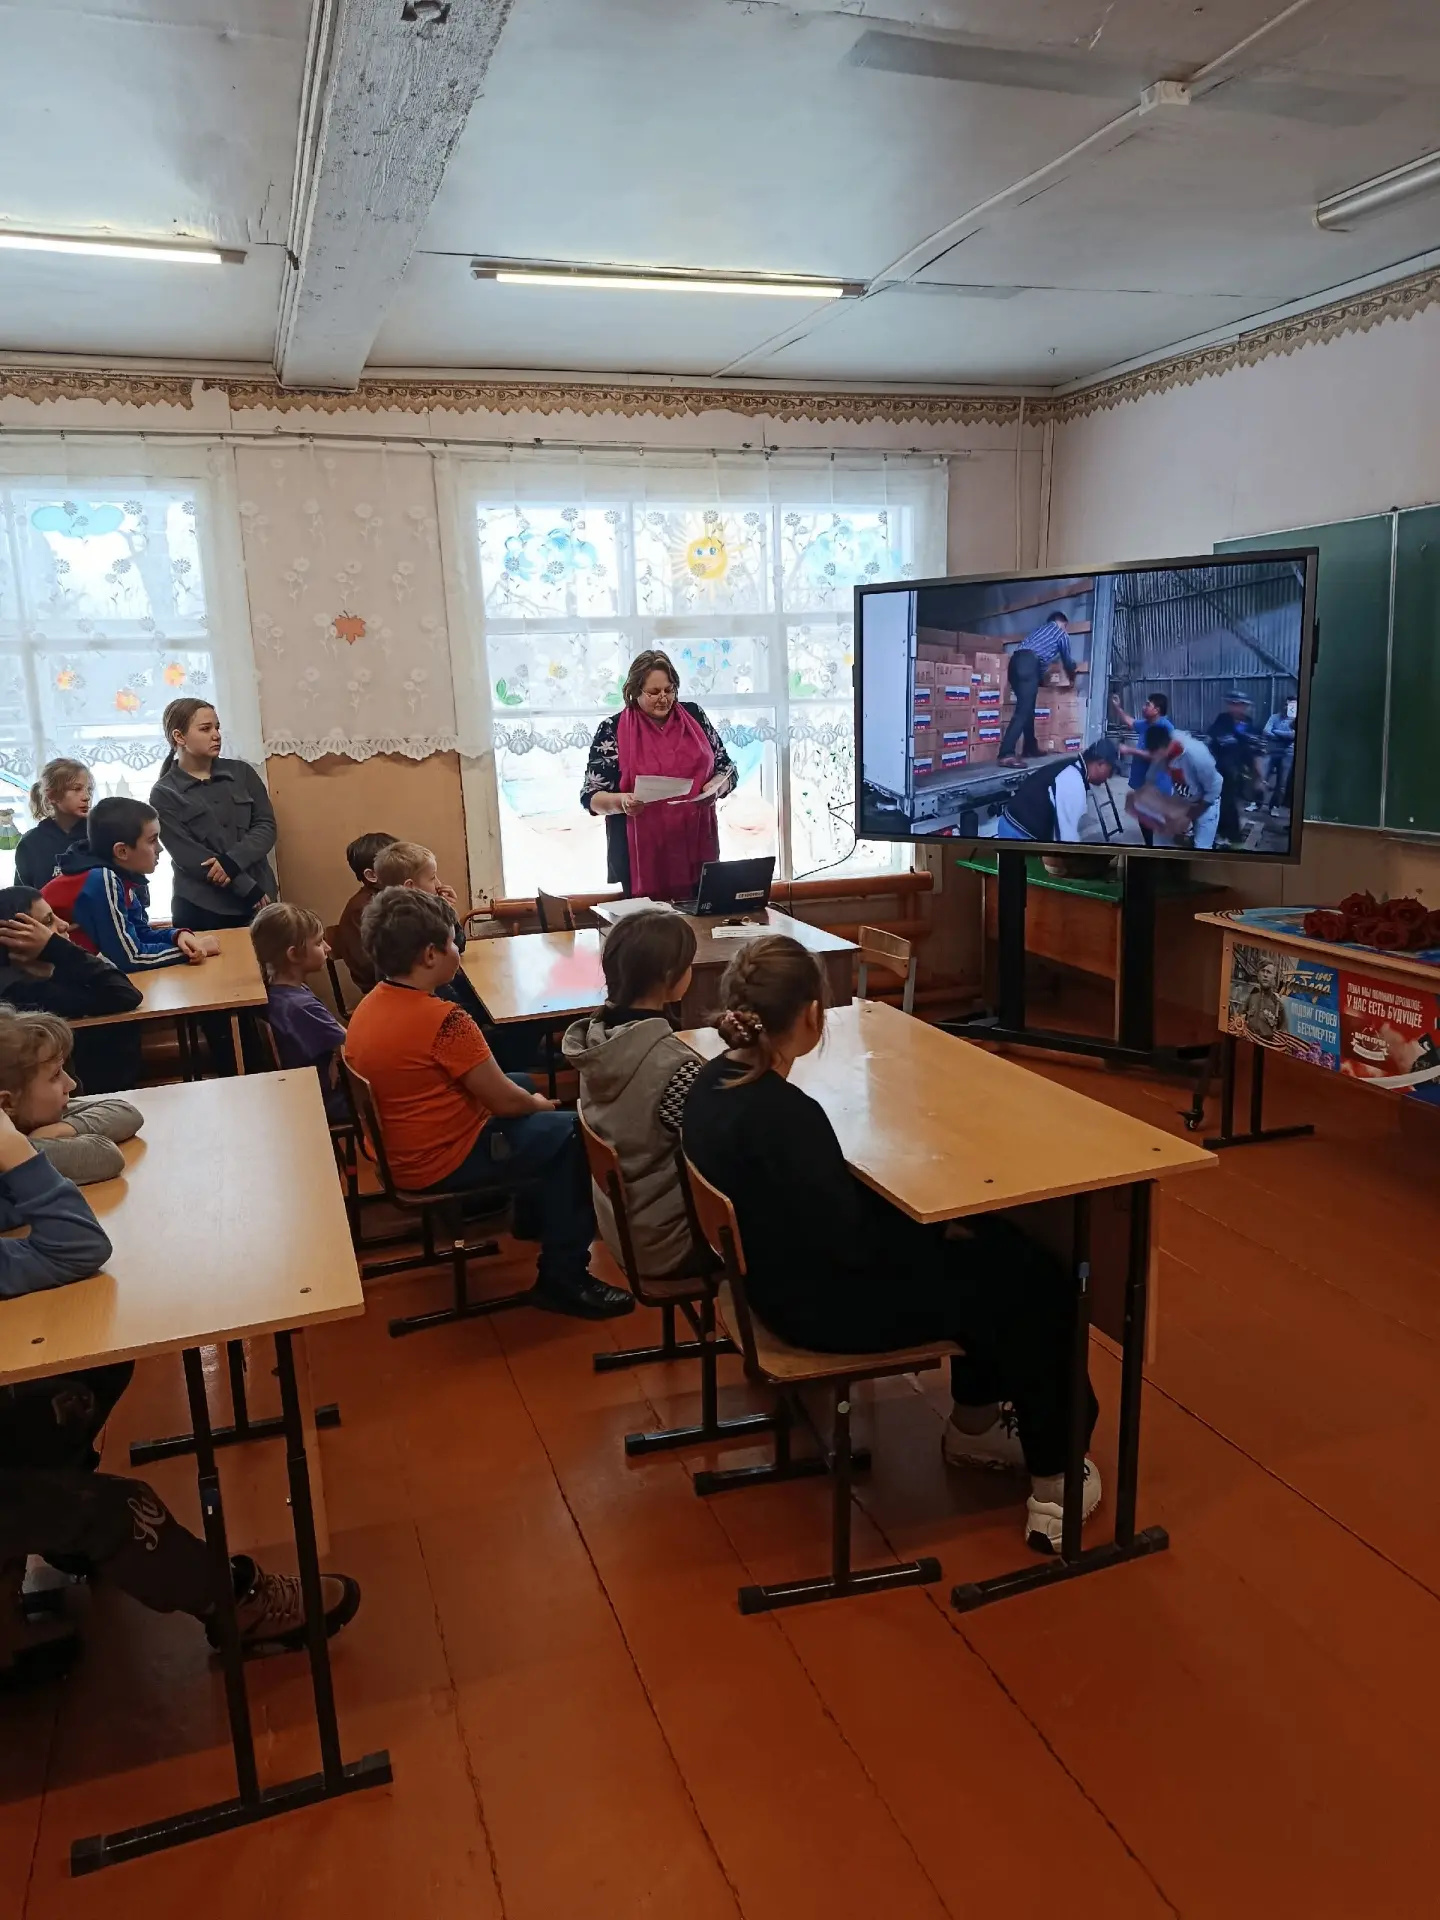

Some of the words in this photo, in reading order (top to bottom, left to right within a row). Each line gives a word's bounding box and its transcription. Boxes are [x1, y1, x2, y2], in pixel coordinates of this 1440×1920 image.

[1315, 1009, 1338, 1027] ГЕРОЕВ
[1346, 994, 1352, 1007] У
[1353, 996, 1367, 1012] НАС
[1368, 1001, 1386, 1017] ЕСТЬ
[1387, 1005, 1423, 1029] БУДУЩЕЕ
[1297, 1020, 1337, 1045] БЕССМЕРТЕН
